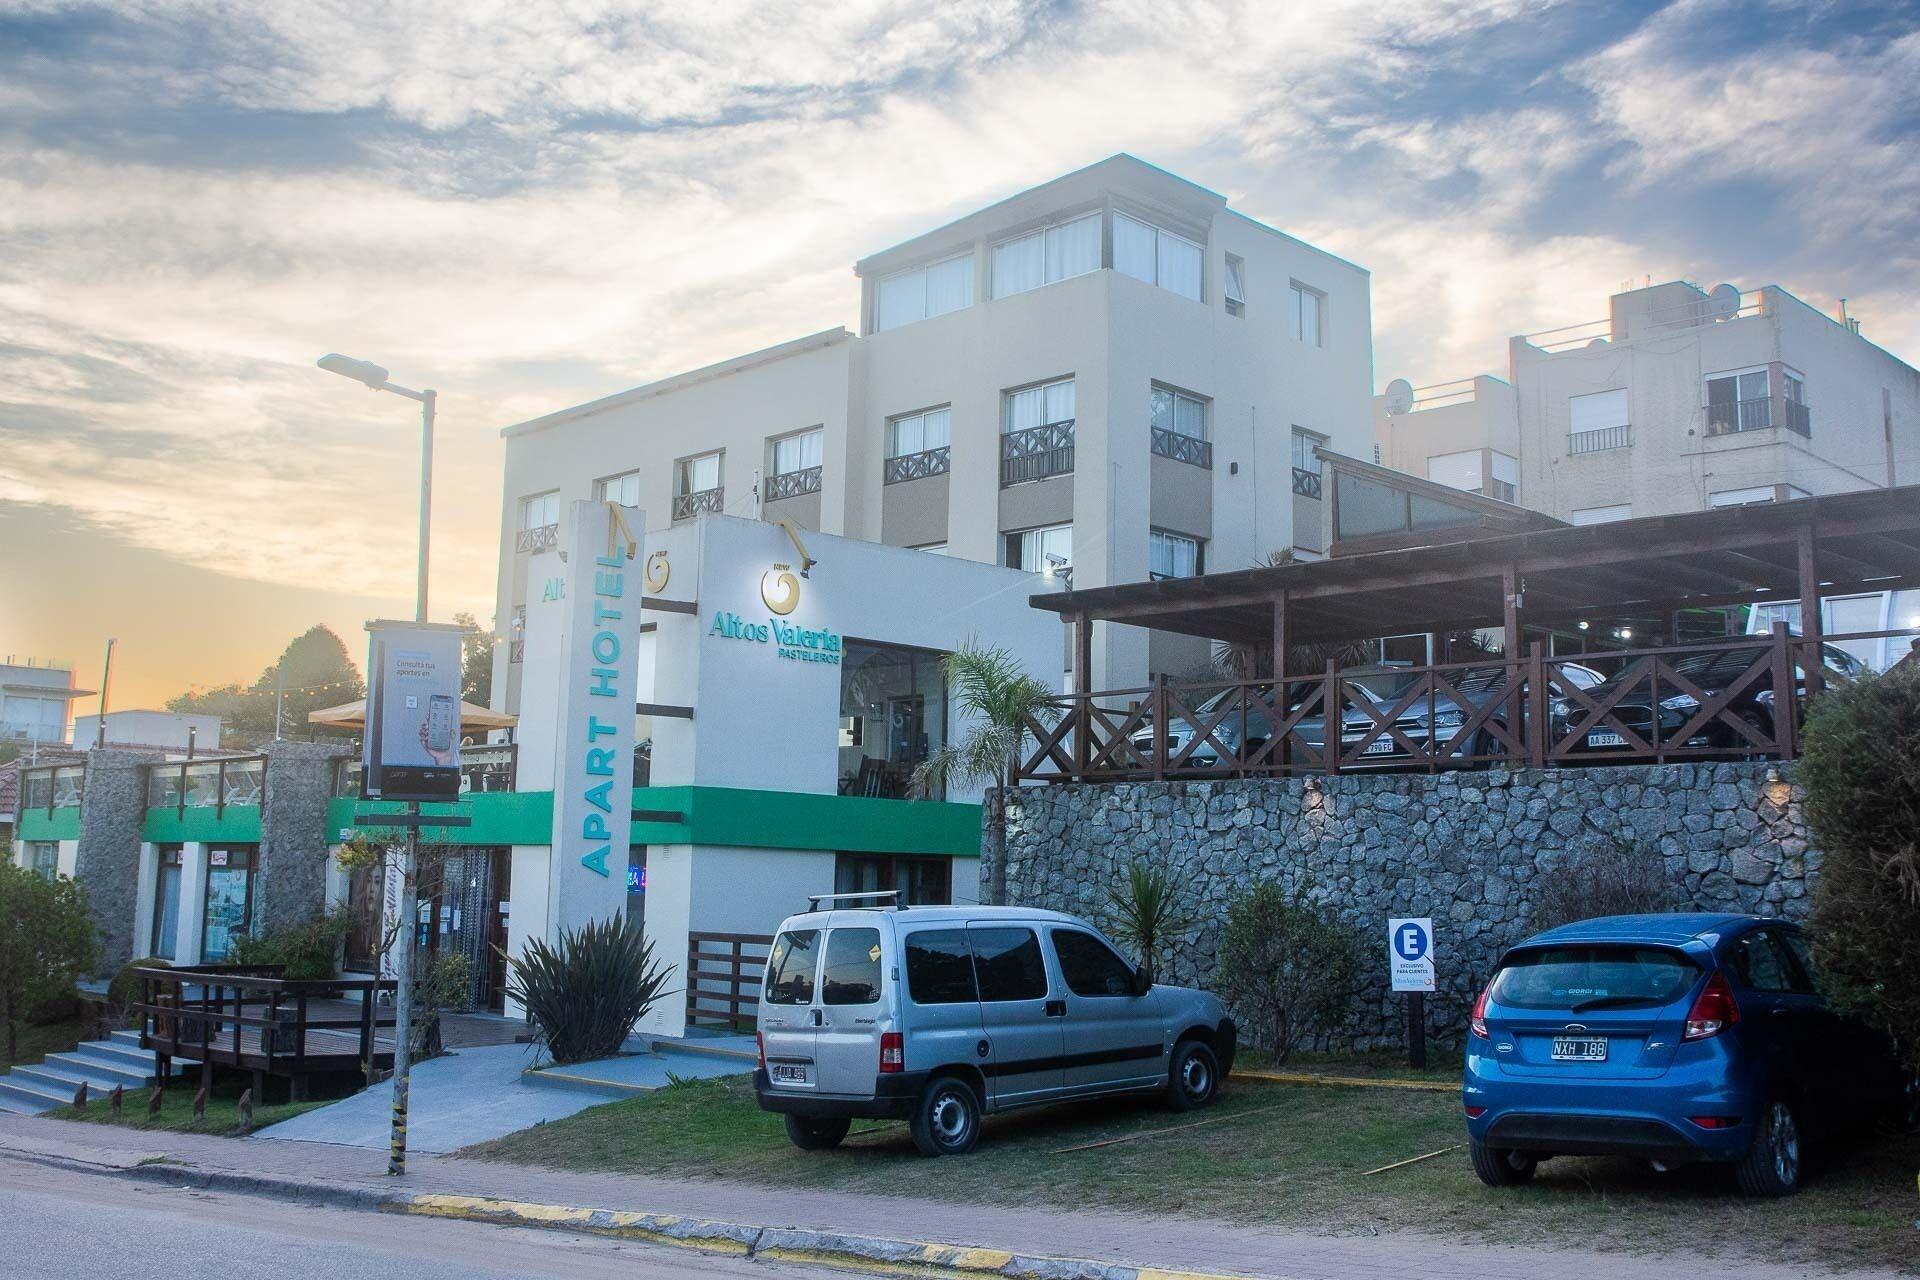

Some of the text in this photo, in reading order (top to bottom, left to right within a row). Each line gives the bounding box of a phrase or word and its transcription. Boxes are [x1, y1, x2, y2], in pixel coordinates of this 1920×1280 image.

[709, 610, 840, 652] Altos Valeria
[778, 648, 840, 664] PASTELEROS
[581, 546, 625, 878] APART HOTEL
[1591, 737, 1600, 745] AA
[1403, 929, 1418, 954] E
[1553, 1042, 1605, 1056] NXH 188
